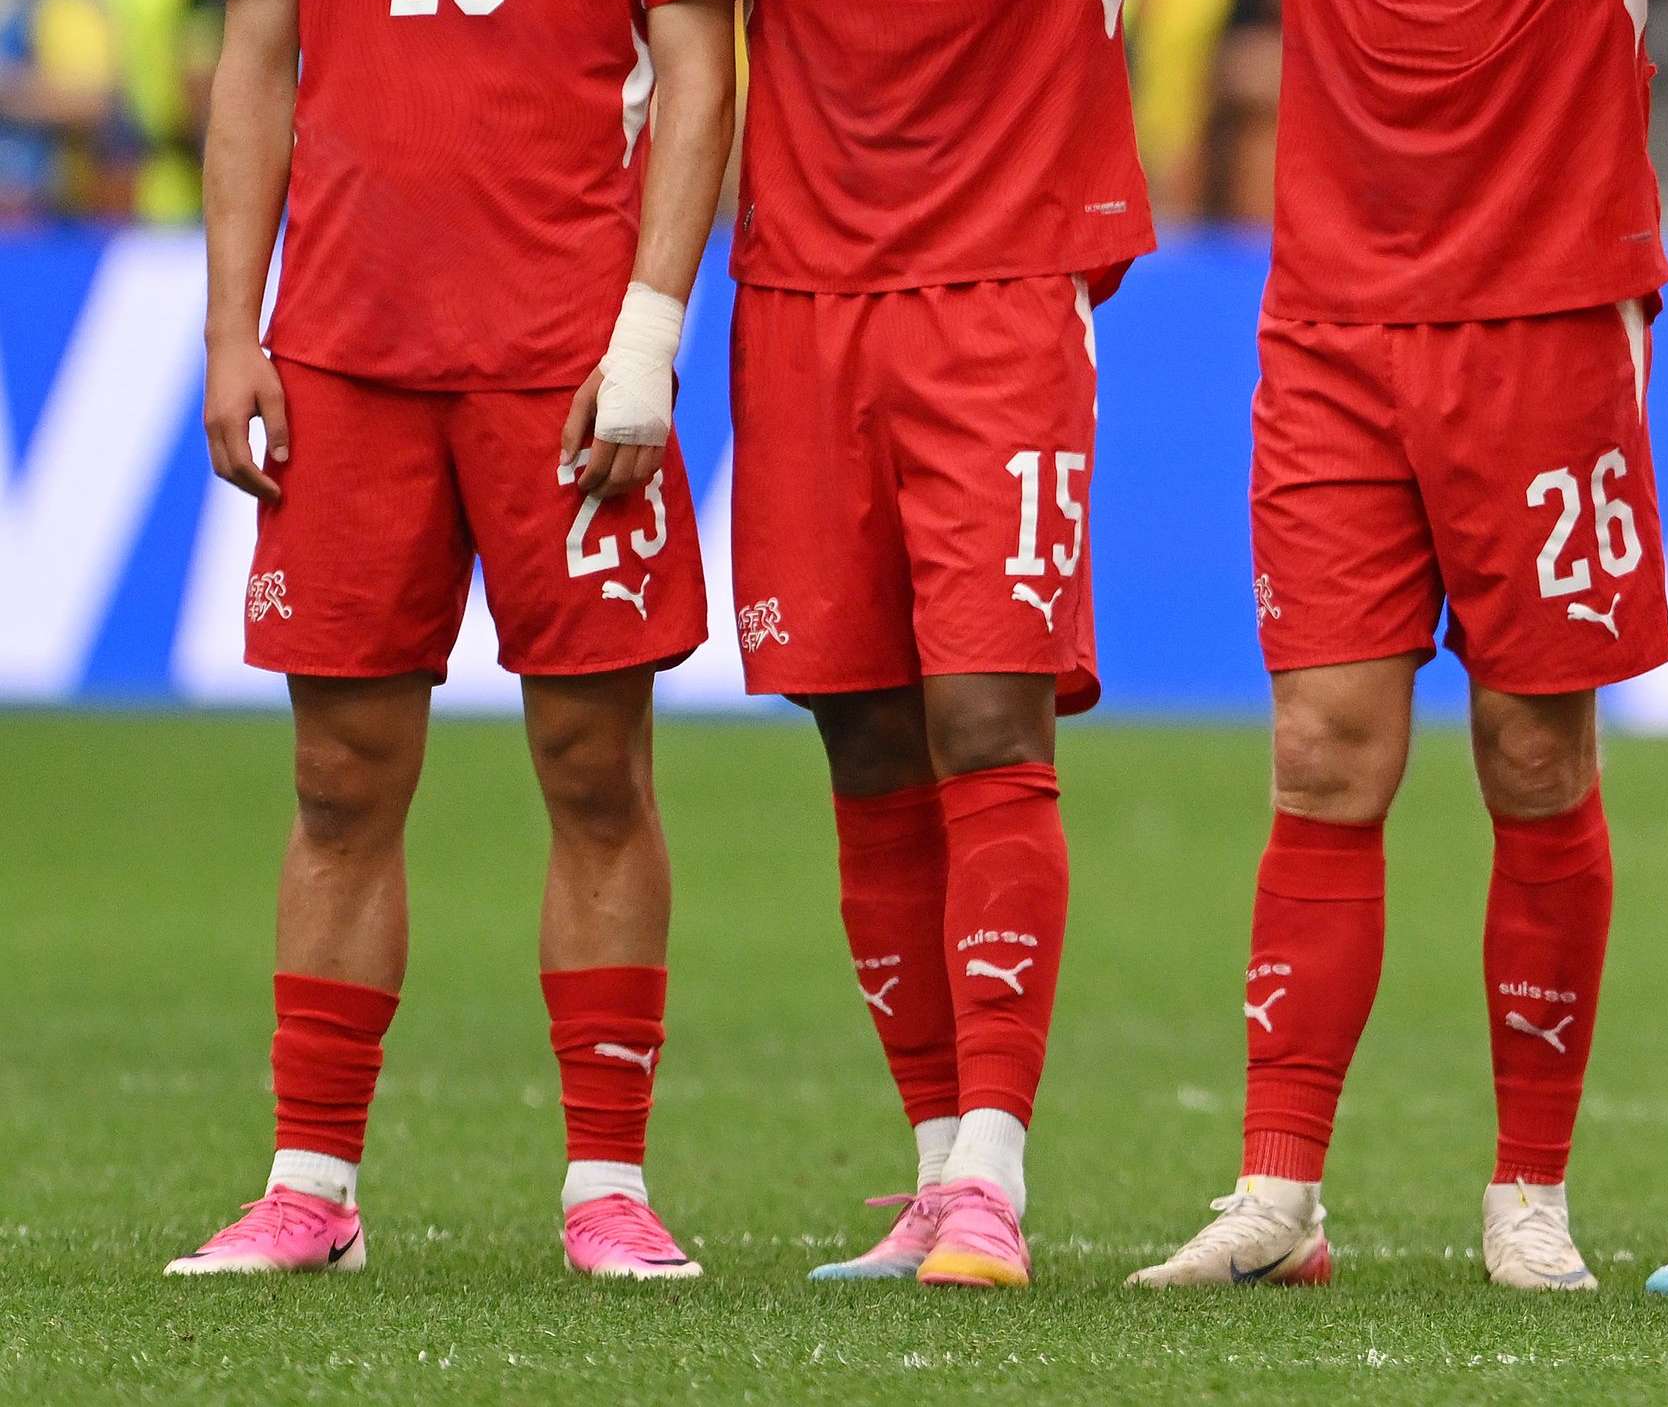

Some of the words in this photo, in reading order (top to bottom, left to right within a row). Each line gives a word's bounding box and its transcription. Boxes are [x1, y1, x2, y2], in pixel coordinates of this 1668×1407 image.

[557, 449, 667, 578] 23
[1005, 450, 1086, 577] 15
[1526, 448, 1643, 598] 26
[958, 928, 1038, 952] suisse
[1499, 981, 1576, 1003] suisse
